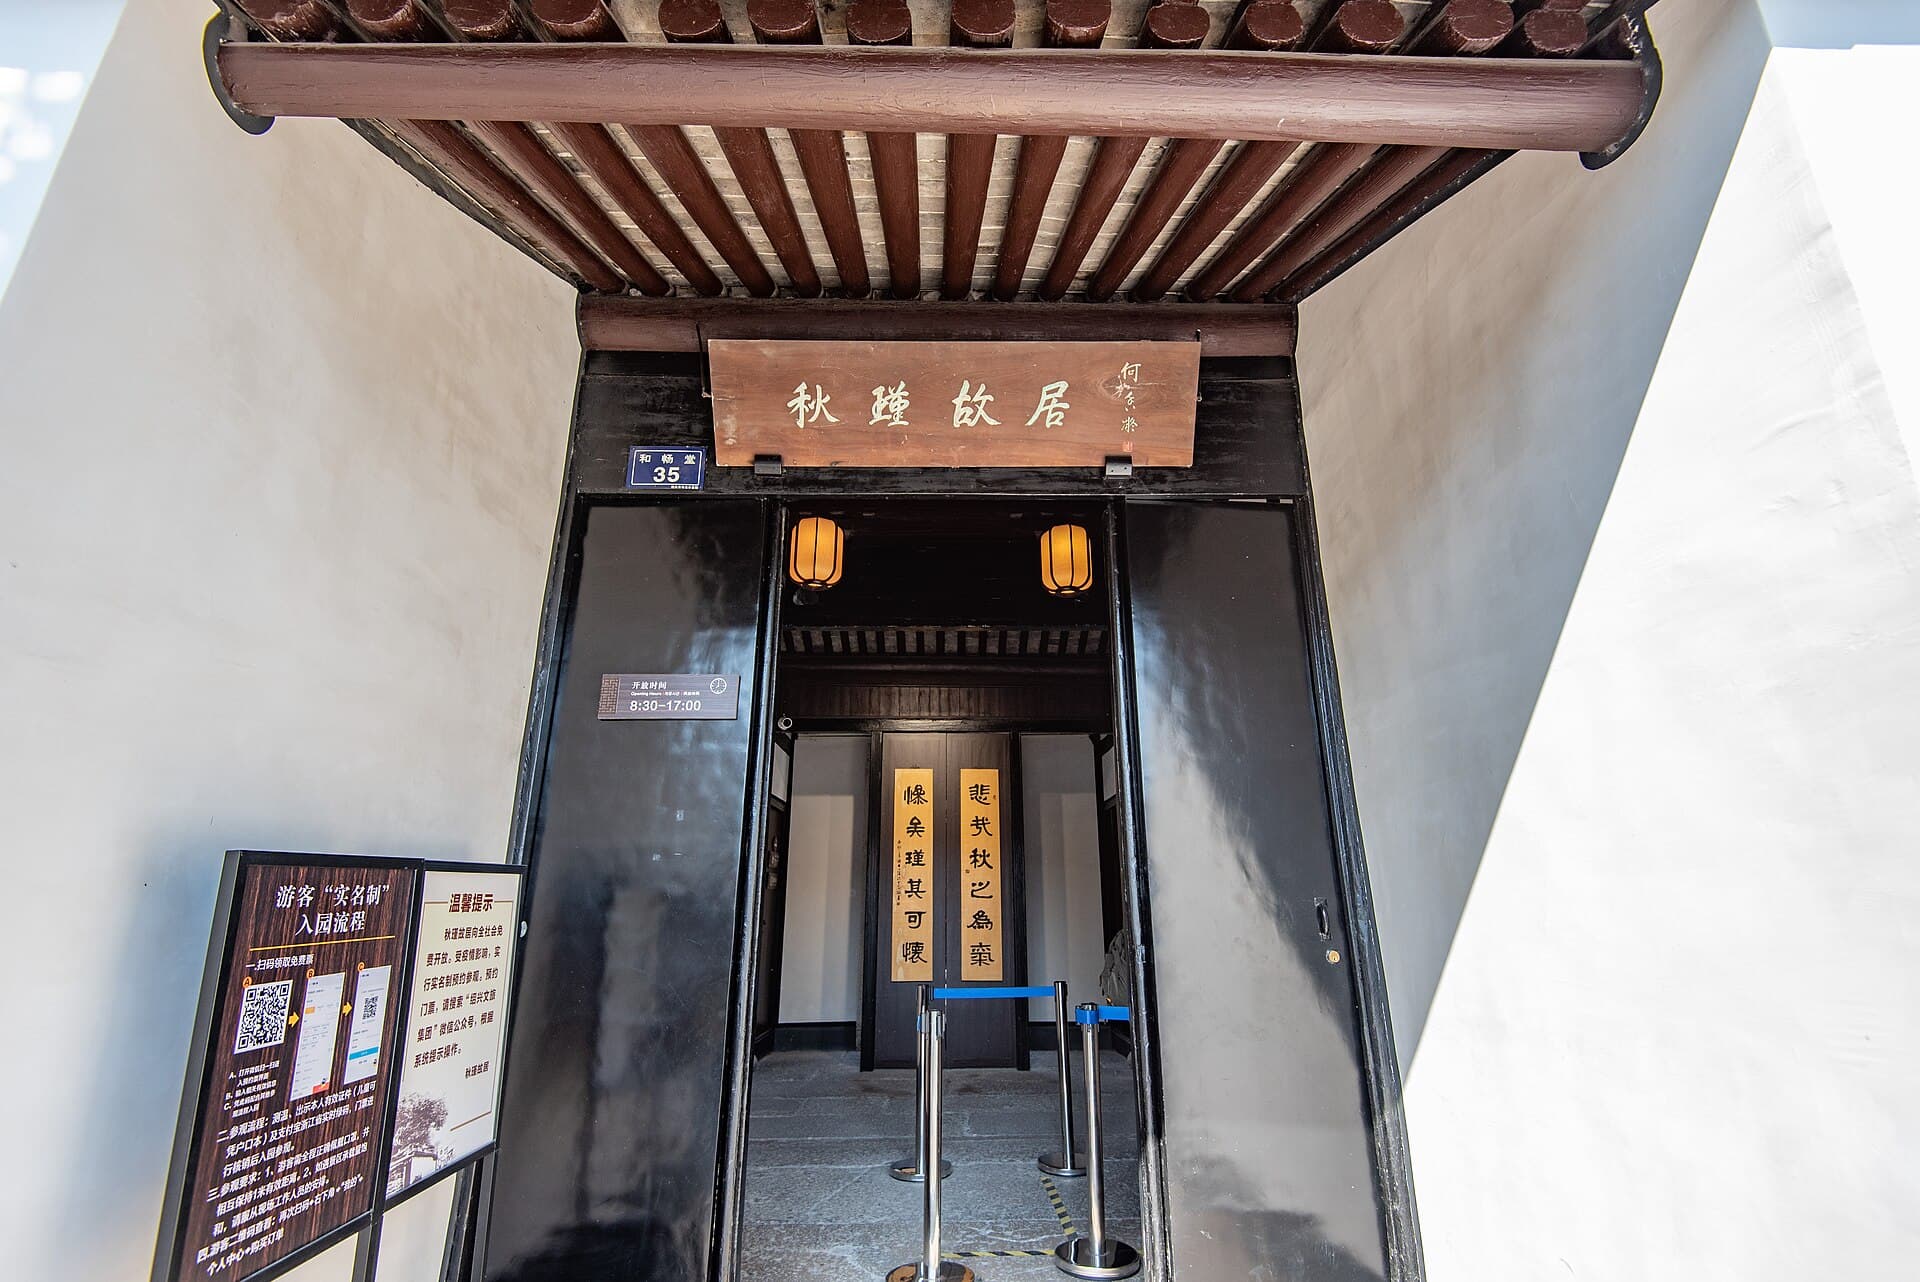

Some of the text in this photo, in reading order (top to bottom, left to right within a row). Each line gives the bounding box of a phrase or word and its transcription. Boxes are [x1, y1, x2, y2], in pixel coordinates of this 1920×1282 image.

[786, 380, 1071, 428] 秋瑾故居
[638, 453, 696, 465] 和畅堂
[653, 466, 681, 483] 35
[631, 681, 667, 690] 开放时间
[275, 883, 390, 909] 游客“实名制”
[448, 893, 494, 913] 温馨提示
[295, 911, 366, 936] 入园流程
[444, 925, 503, 941] 秋瑾故居向全社会免
[465, 1061, 489, 1079] 秋瑾故居
